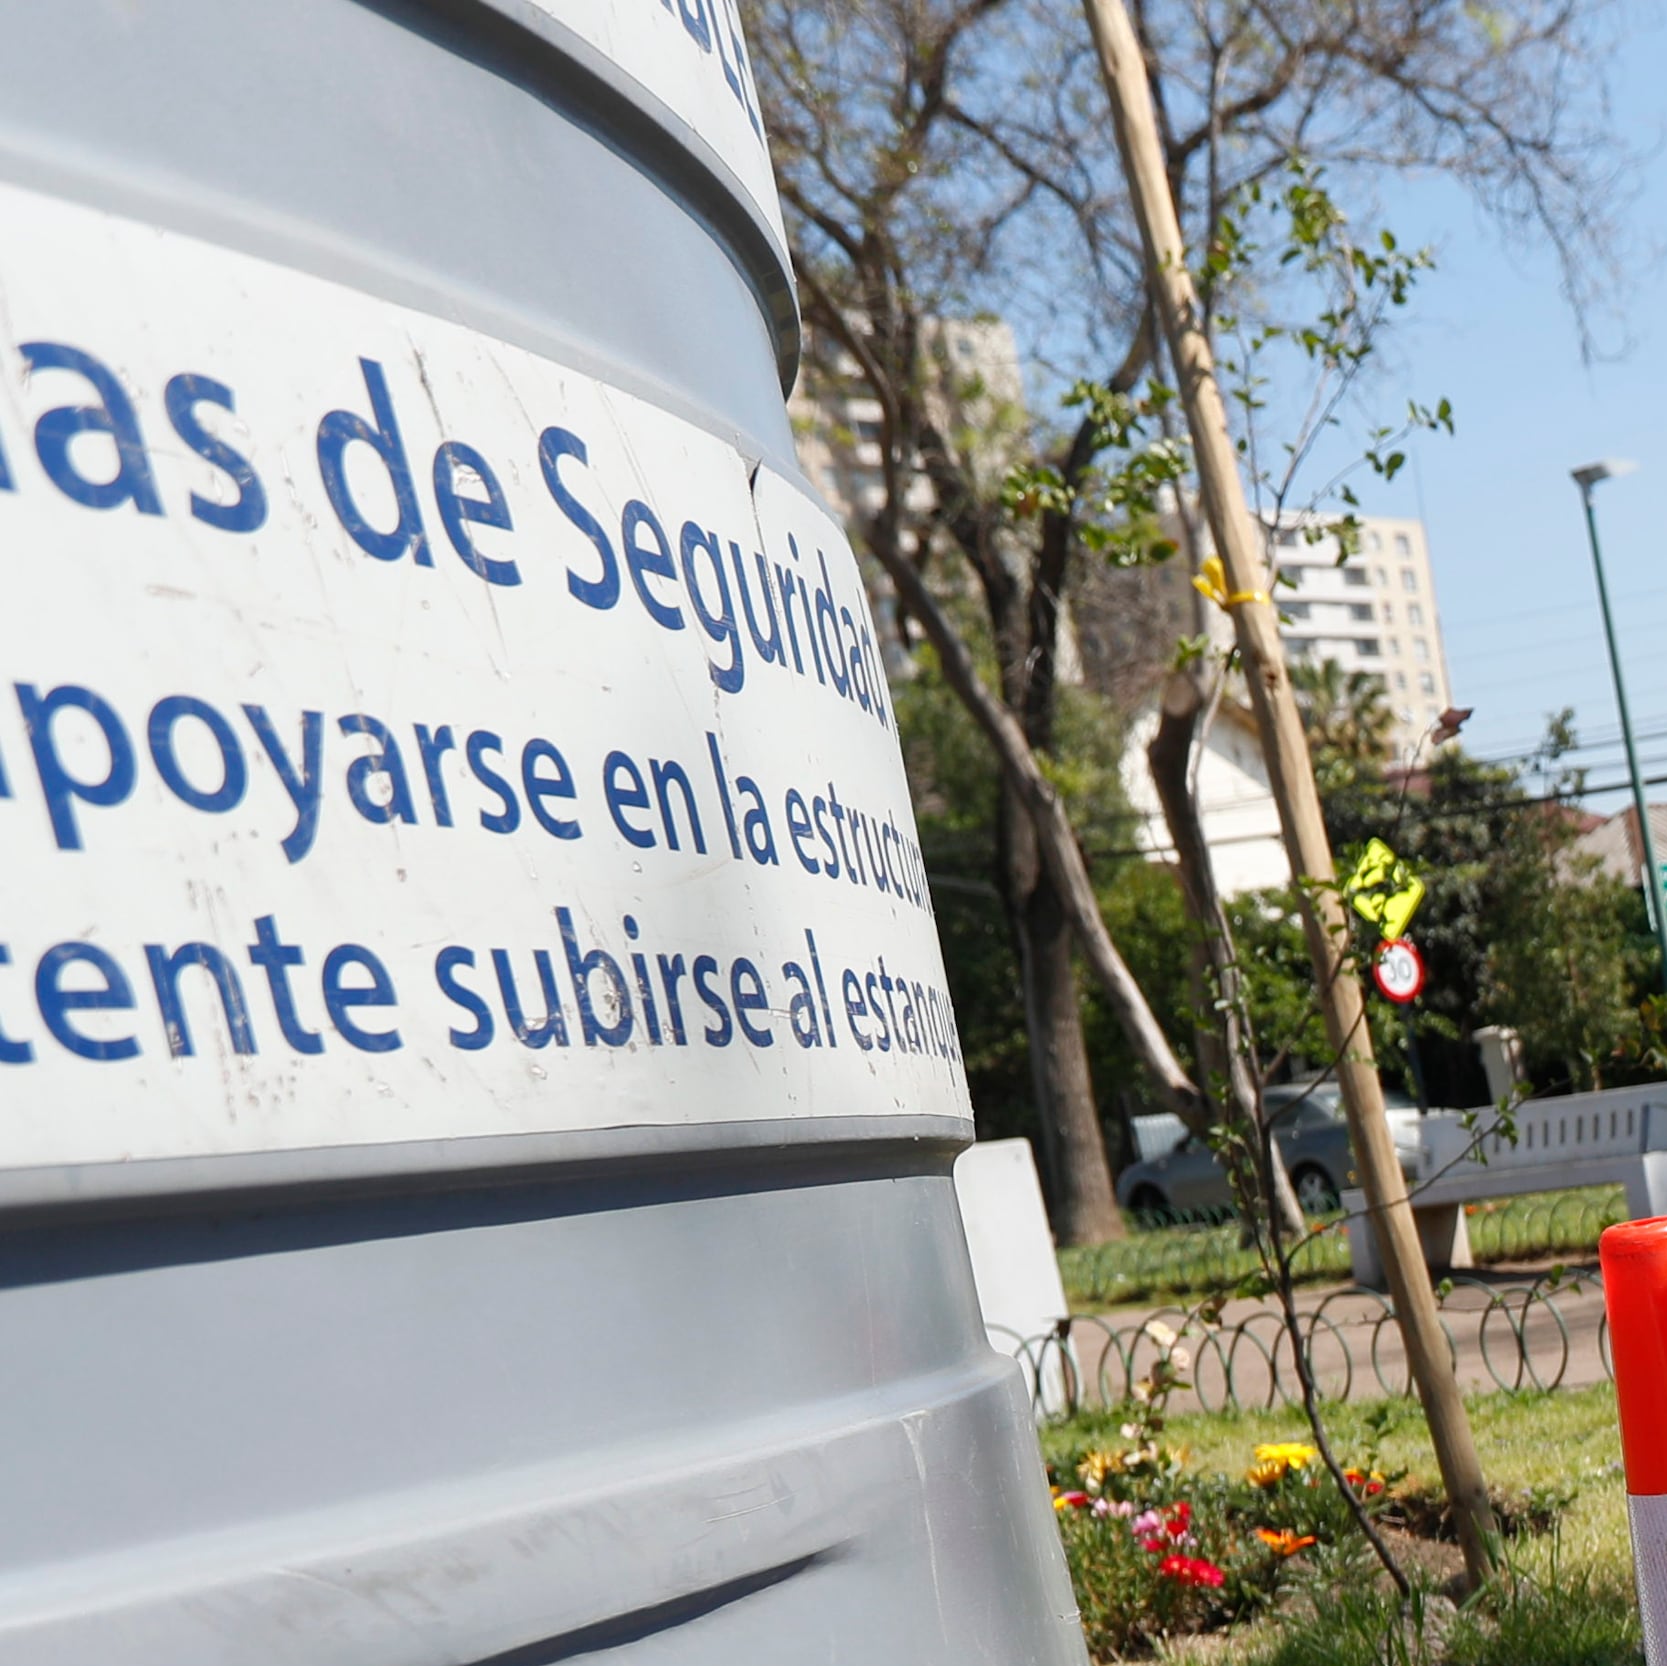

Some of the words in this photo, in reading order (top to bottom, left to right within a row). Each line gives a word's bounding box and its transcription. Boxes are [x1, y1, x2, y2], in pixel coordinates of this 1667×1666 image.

[0, 341, 269, 533] as
[316, 356, 522, 588] de
[538, 425, 890, 732] Seguridad
[0, 681, 581, 864] poyarse
[603, 746, 709, 857] en
[704, 730, 781, 867] la
[435, 906, 772, 1051] subirse
[781, 928, 838, 1048] al
